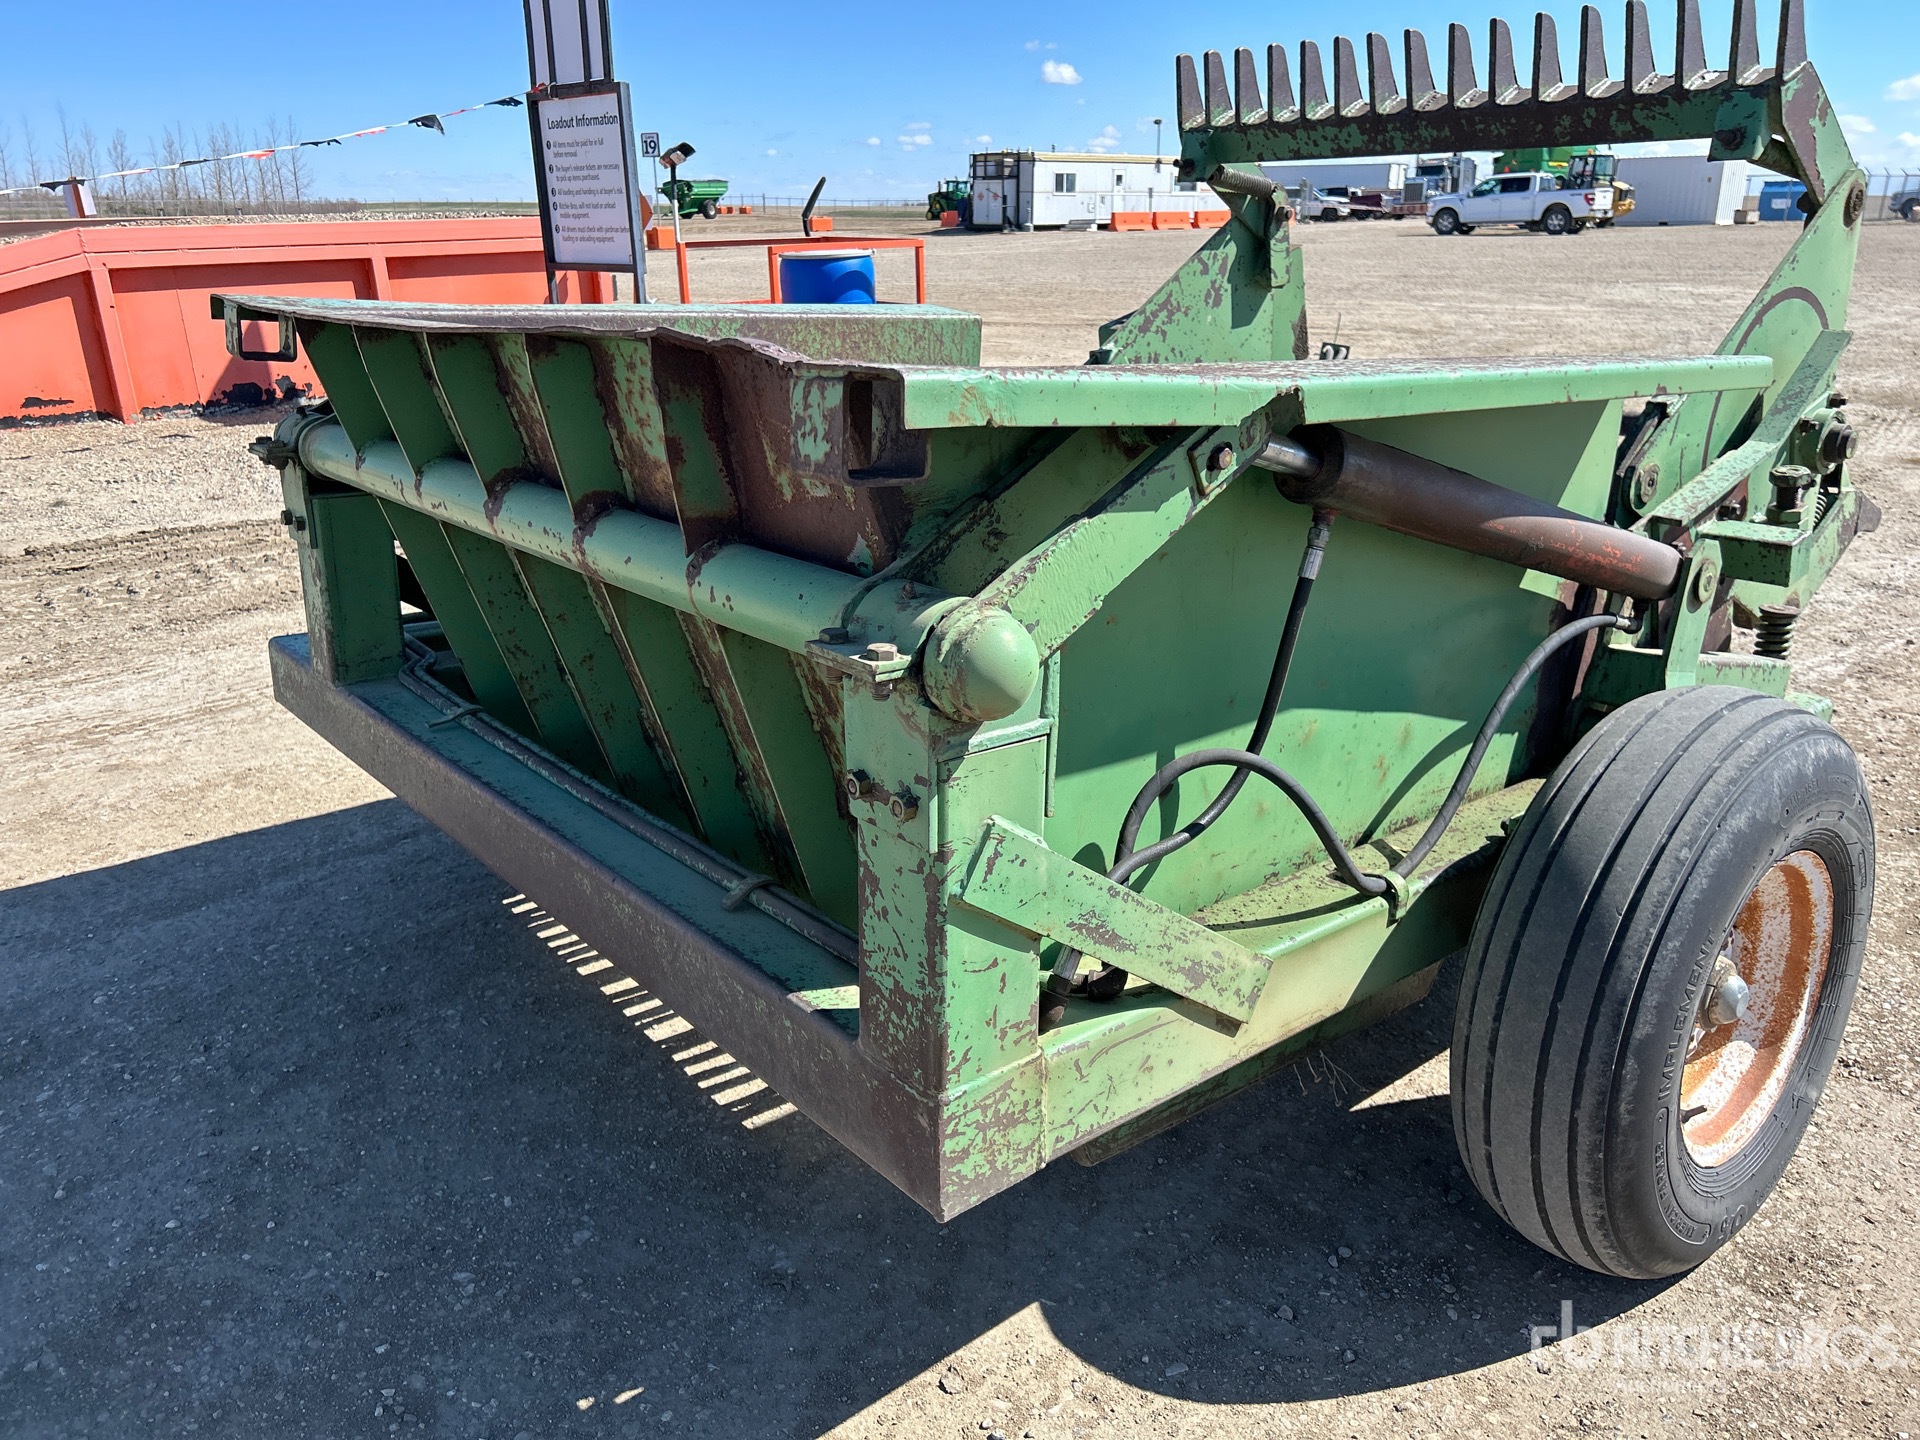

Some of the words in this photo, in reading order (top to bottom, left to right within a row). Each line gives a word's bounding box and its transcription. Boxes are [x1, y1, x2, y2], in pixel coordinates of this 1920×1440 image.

[548, 116, 574, 129] Loadout
[576, 112, 618, 127] Information
[580, 139, 588, 148] paid
[643, 140, 657, 154] 19
[585, 163, 596, 171] tickets
[563, 188, 575, 197] loading
[581, 187, 596, 196] handling
[1658, 927, 1715, 1101] IMPLEMENT
[1655, 1140, 1668, 1202] FARMER
